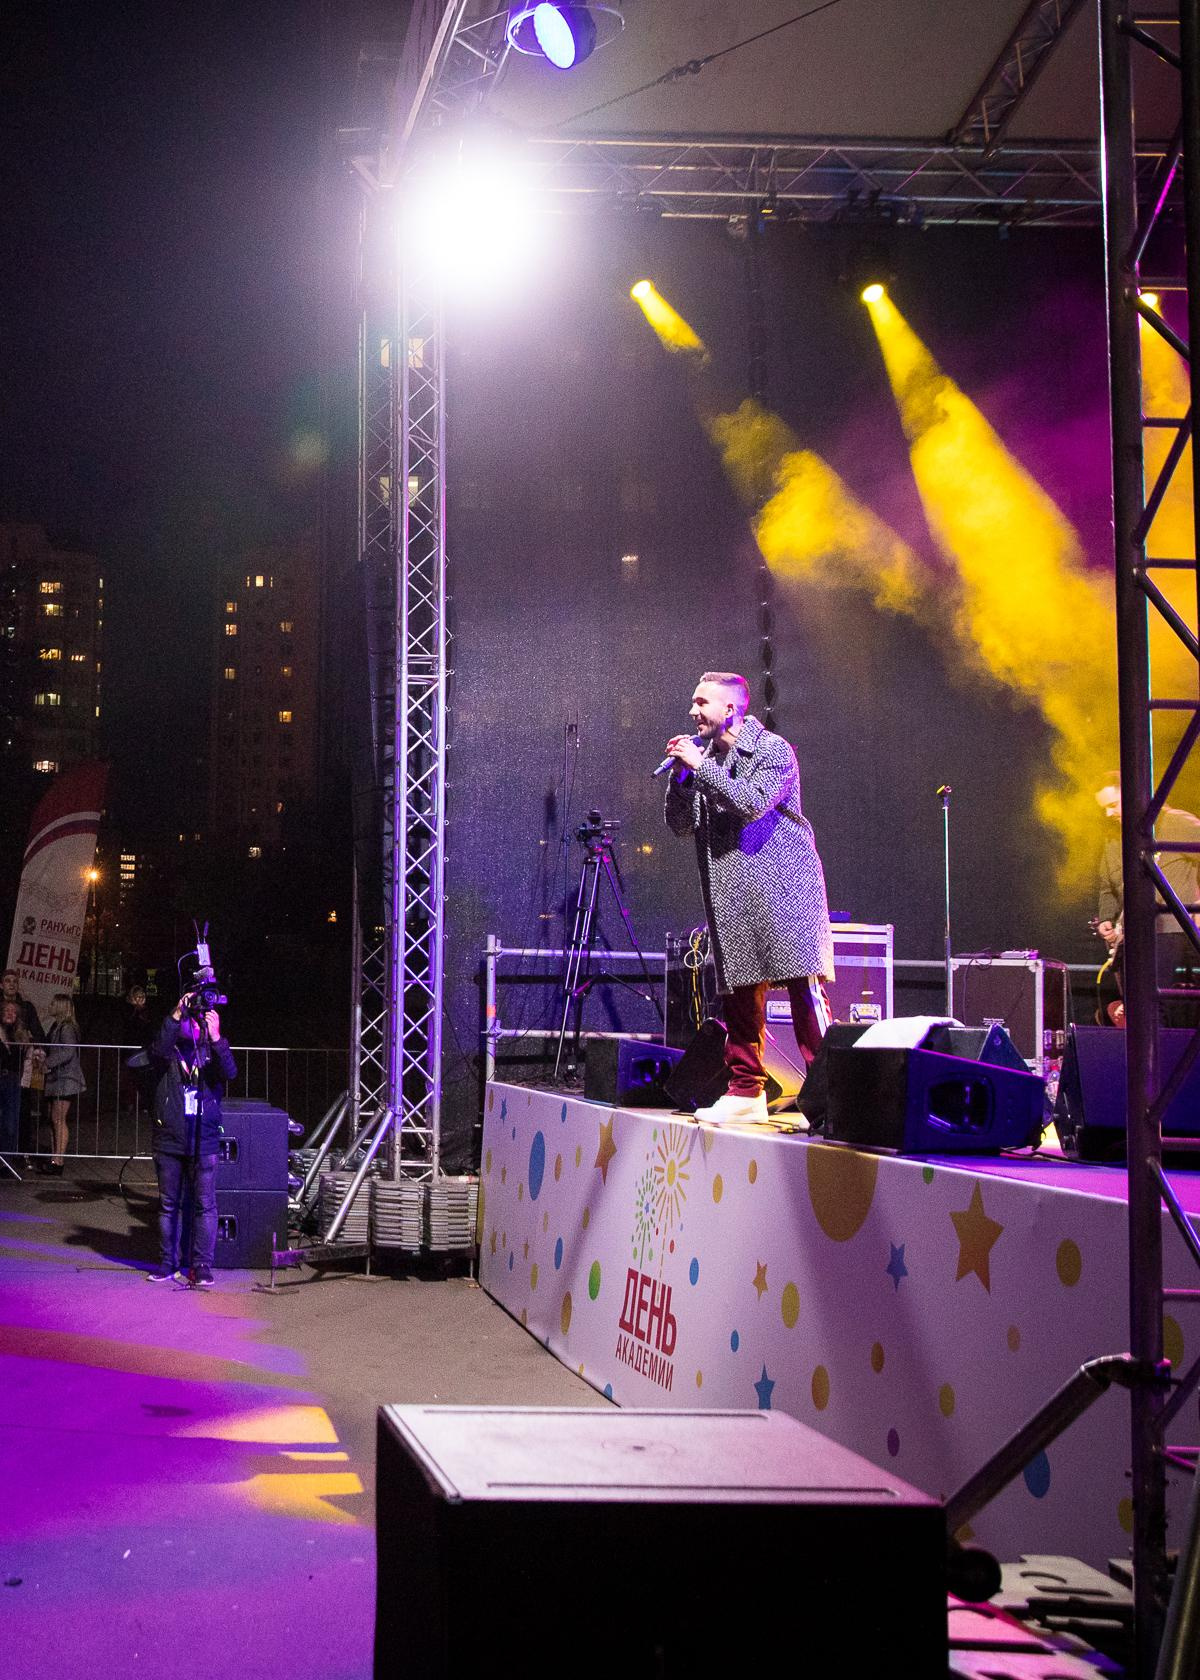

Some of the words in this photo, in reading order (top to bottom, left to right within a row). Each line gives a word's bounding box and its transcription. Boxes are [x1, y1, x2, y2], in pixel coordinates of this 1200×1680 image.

[40, 919, 80, 937] РАНХиГС
[16, 941, 76, 974] ДЕНЬ
[618, 1267, 677, 1357] ДЕНЬ
[615, 1333, 674, 1393] АКАДЕМИИ
